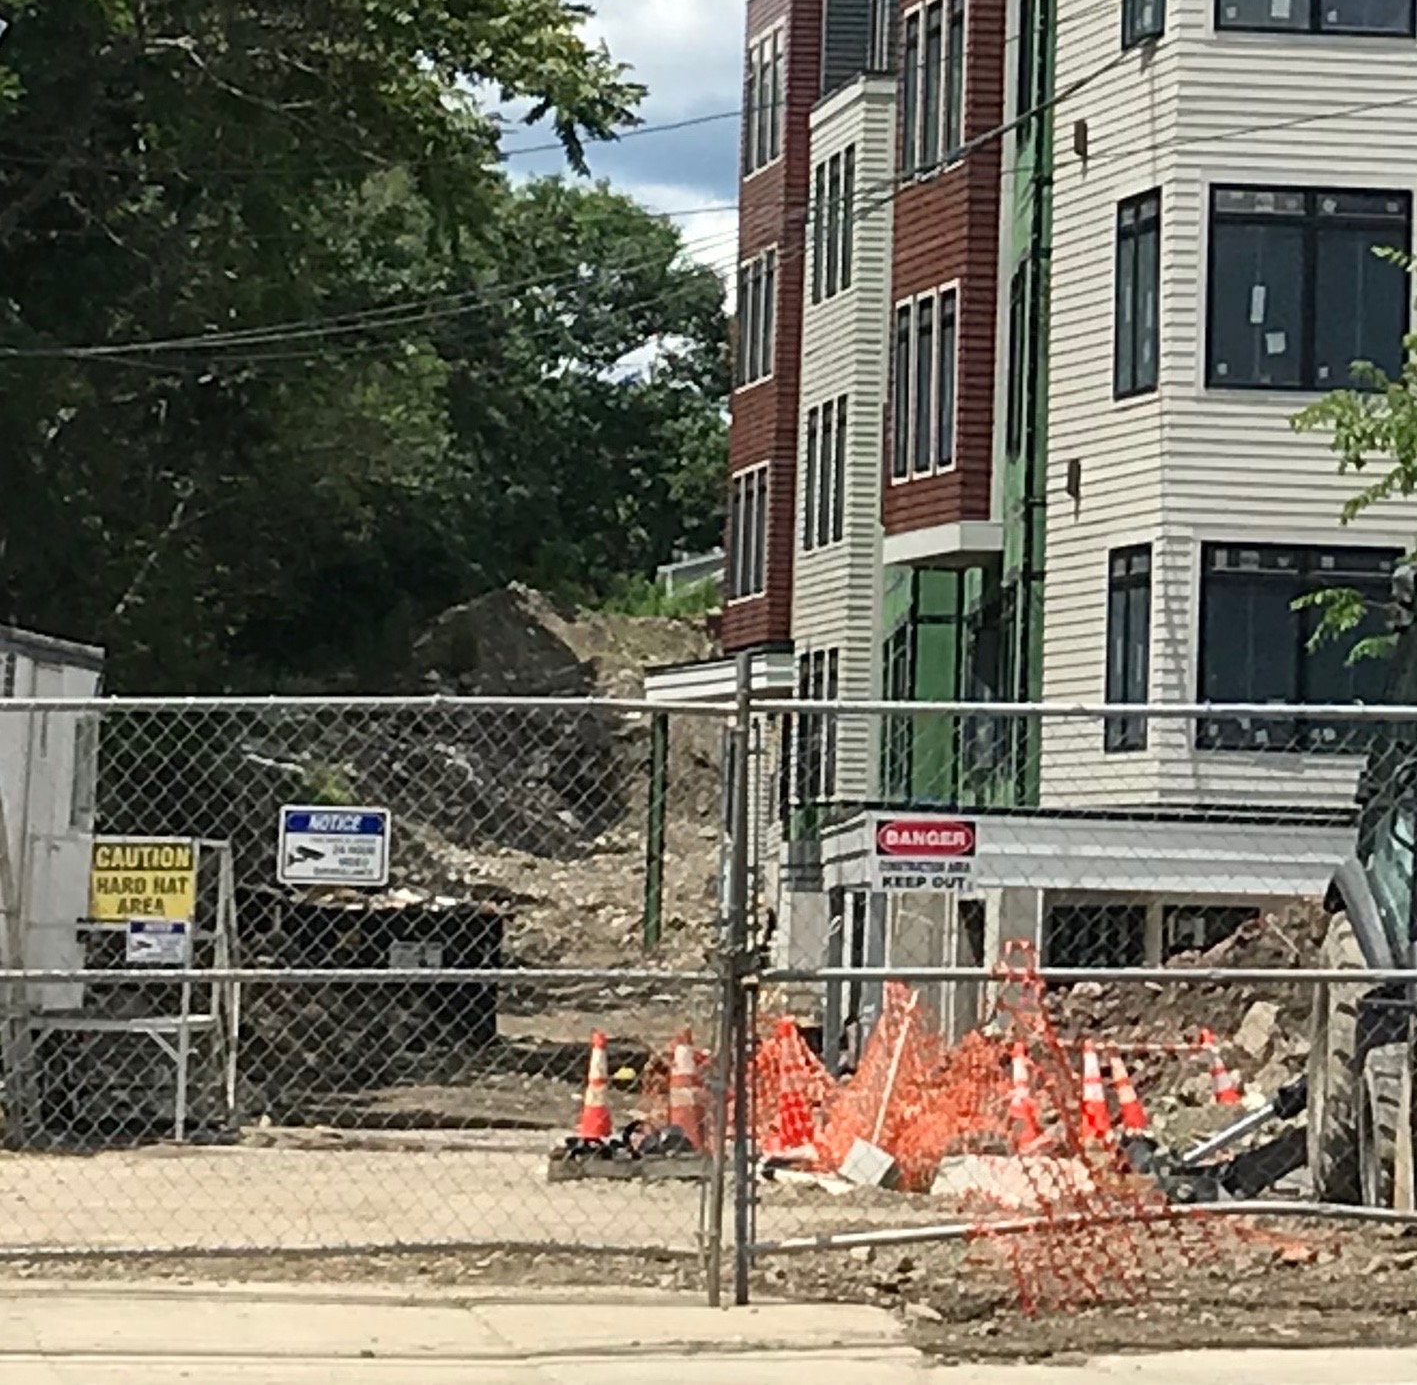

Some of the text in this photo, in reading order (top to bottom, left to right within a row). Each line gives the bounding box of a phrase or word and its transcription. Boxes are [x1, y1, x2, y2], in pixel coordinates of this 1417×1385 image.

[308, 814, 363, 831] NOTICE
[886, 829, 966, 846] DANGER
[96, 846, 190, 868] CAUTION
[96, 876, 189, 895] HARD HAT
[882, 876, 966, 889] KEEP OUT
[116, 896, 166, 915] AREA
